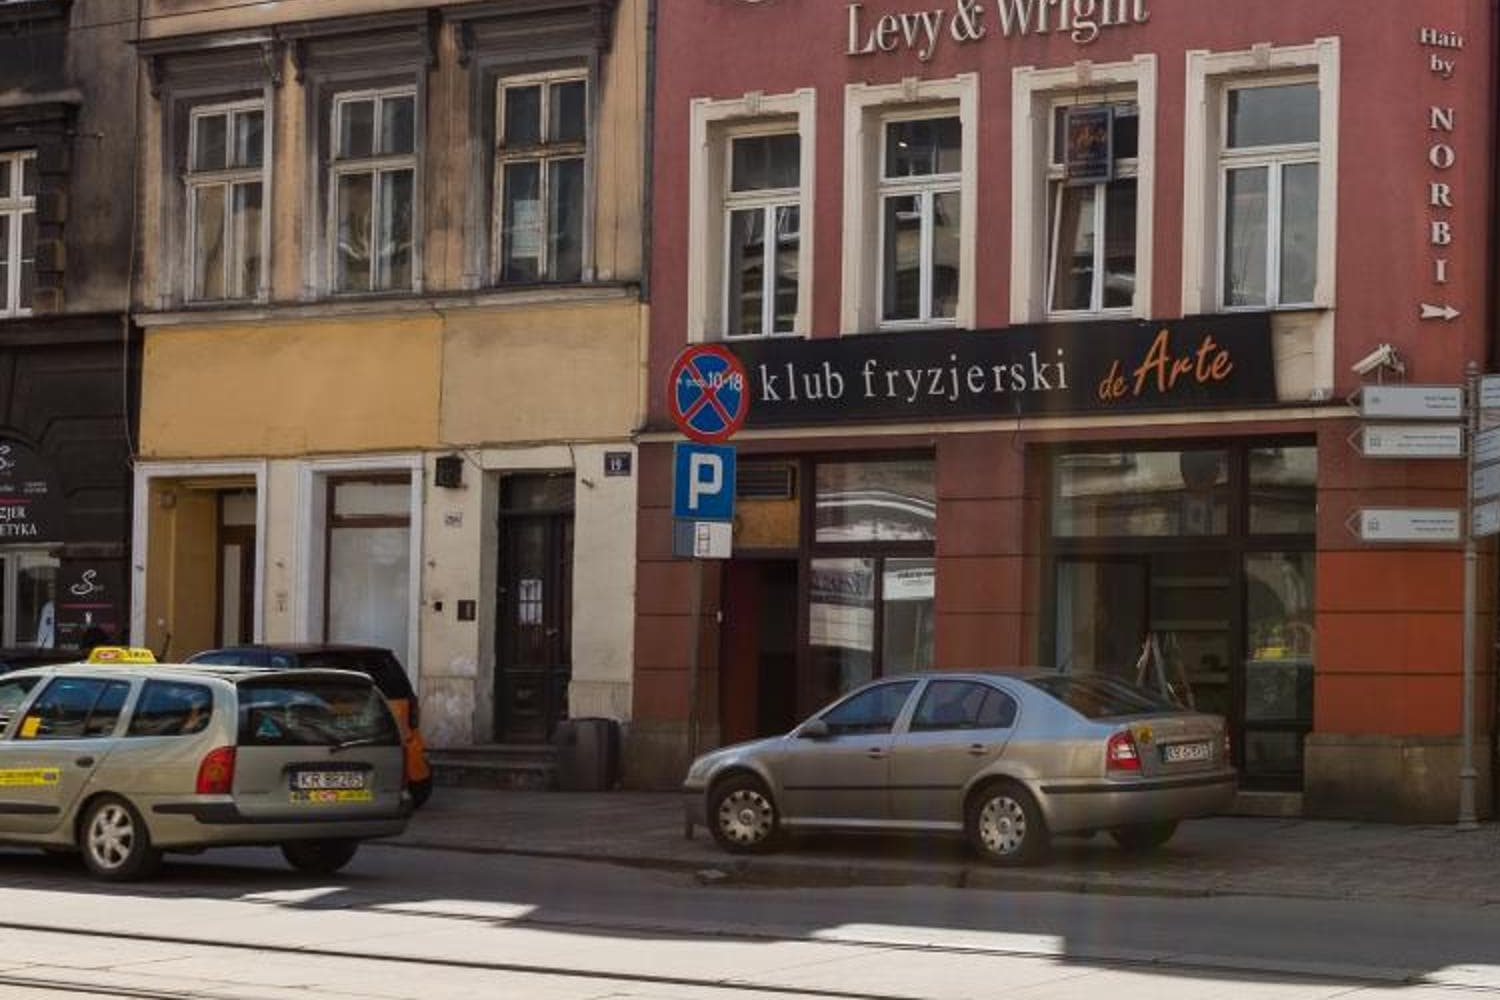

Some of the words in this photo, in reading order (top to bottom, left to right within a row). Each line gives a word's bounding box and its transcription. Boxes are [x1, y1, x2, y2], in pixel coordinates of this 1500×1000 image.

[846, 3, 943, 62] Levy
[1420, 27, 1463, 50] Hair
[1430, 54, 1455, 77] by
[1429, 106, 1455, 283] NORBI
[760, 361, 845, 402] klub
[862, 348, 1069, 403] fryzjerski
[1098, 360, 1128, 401] de
[1133, 328, 1233, 397] Arte
[688, 453, 723, 510] P
